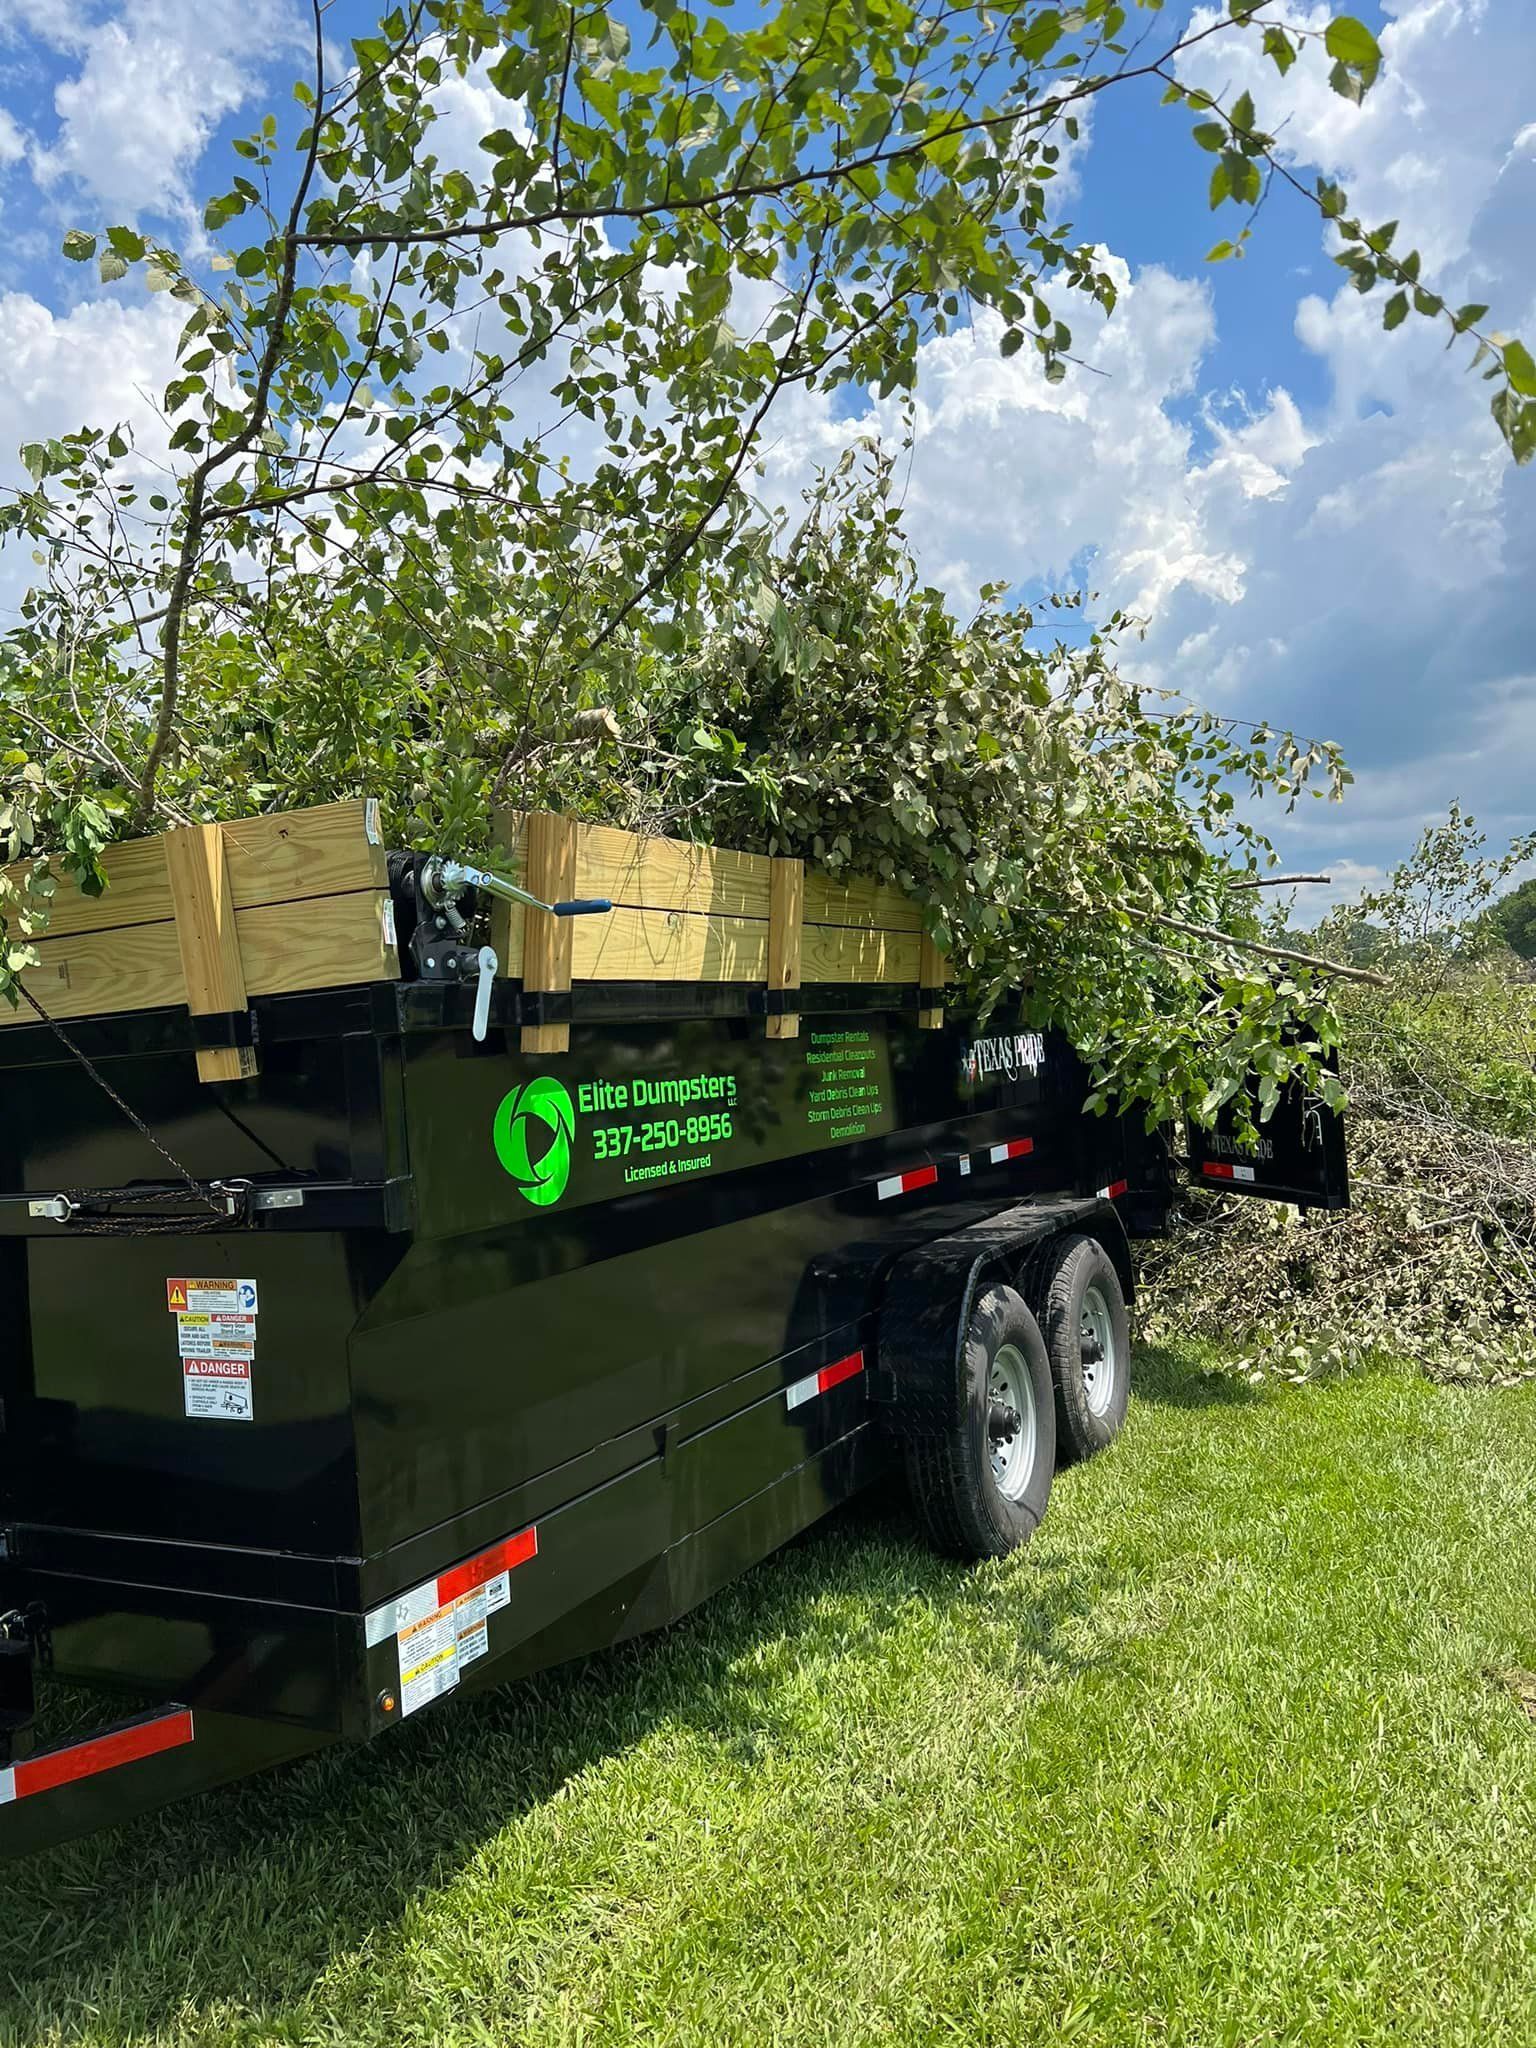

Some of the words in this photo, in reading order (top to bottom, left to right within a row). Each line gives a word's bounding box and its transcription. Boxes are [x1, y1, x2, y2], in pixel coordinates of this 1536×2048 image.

[811, 1032, 844, 1045] Dumpster
[845, 1031, 869, 1042] Rentals
[806, 1050, 844, 1064] Residential
[845, 1049, 876, 1061] Cleanouts
[974, 1036, 1018, 1082] TEXAS
[1014, 1033, 1045, 1077] PRIDE
[821, 1069, 838, 1082] Junk
[838, 1066, 865, 1079] Removal
[578, 1079, 628, 1112] Elite
[632, 1074, 737, 1107] Dumpsters
[809, 1089, 826, 1102] Yard
[826, 1086, 848, 1100] Debris
[848, 1086, 866, 1098] Clean
[866, 1084, 879, 1097] Ups
[808, 1109, 830, 1122] Storm
[830, 1105, 852, 1120] Debris
[852, 1103, 870, 1116] Clean
[869, 1102, 882, 1115] Ups
[593, 1113, 733, 1159] 337-250-8956
[830, 1121, 866, 1139] Demolition
[625, 1159, 668, 1183] Licensed
[668, 1161, 677, 1175] &
[678, 1154, 712, 1172] Insured
[196, 1280, 234, 1290] WARNING
[200, 1363, 246, 1375] DANGER
